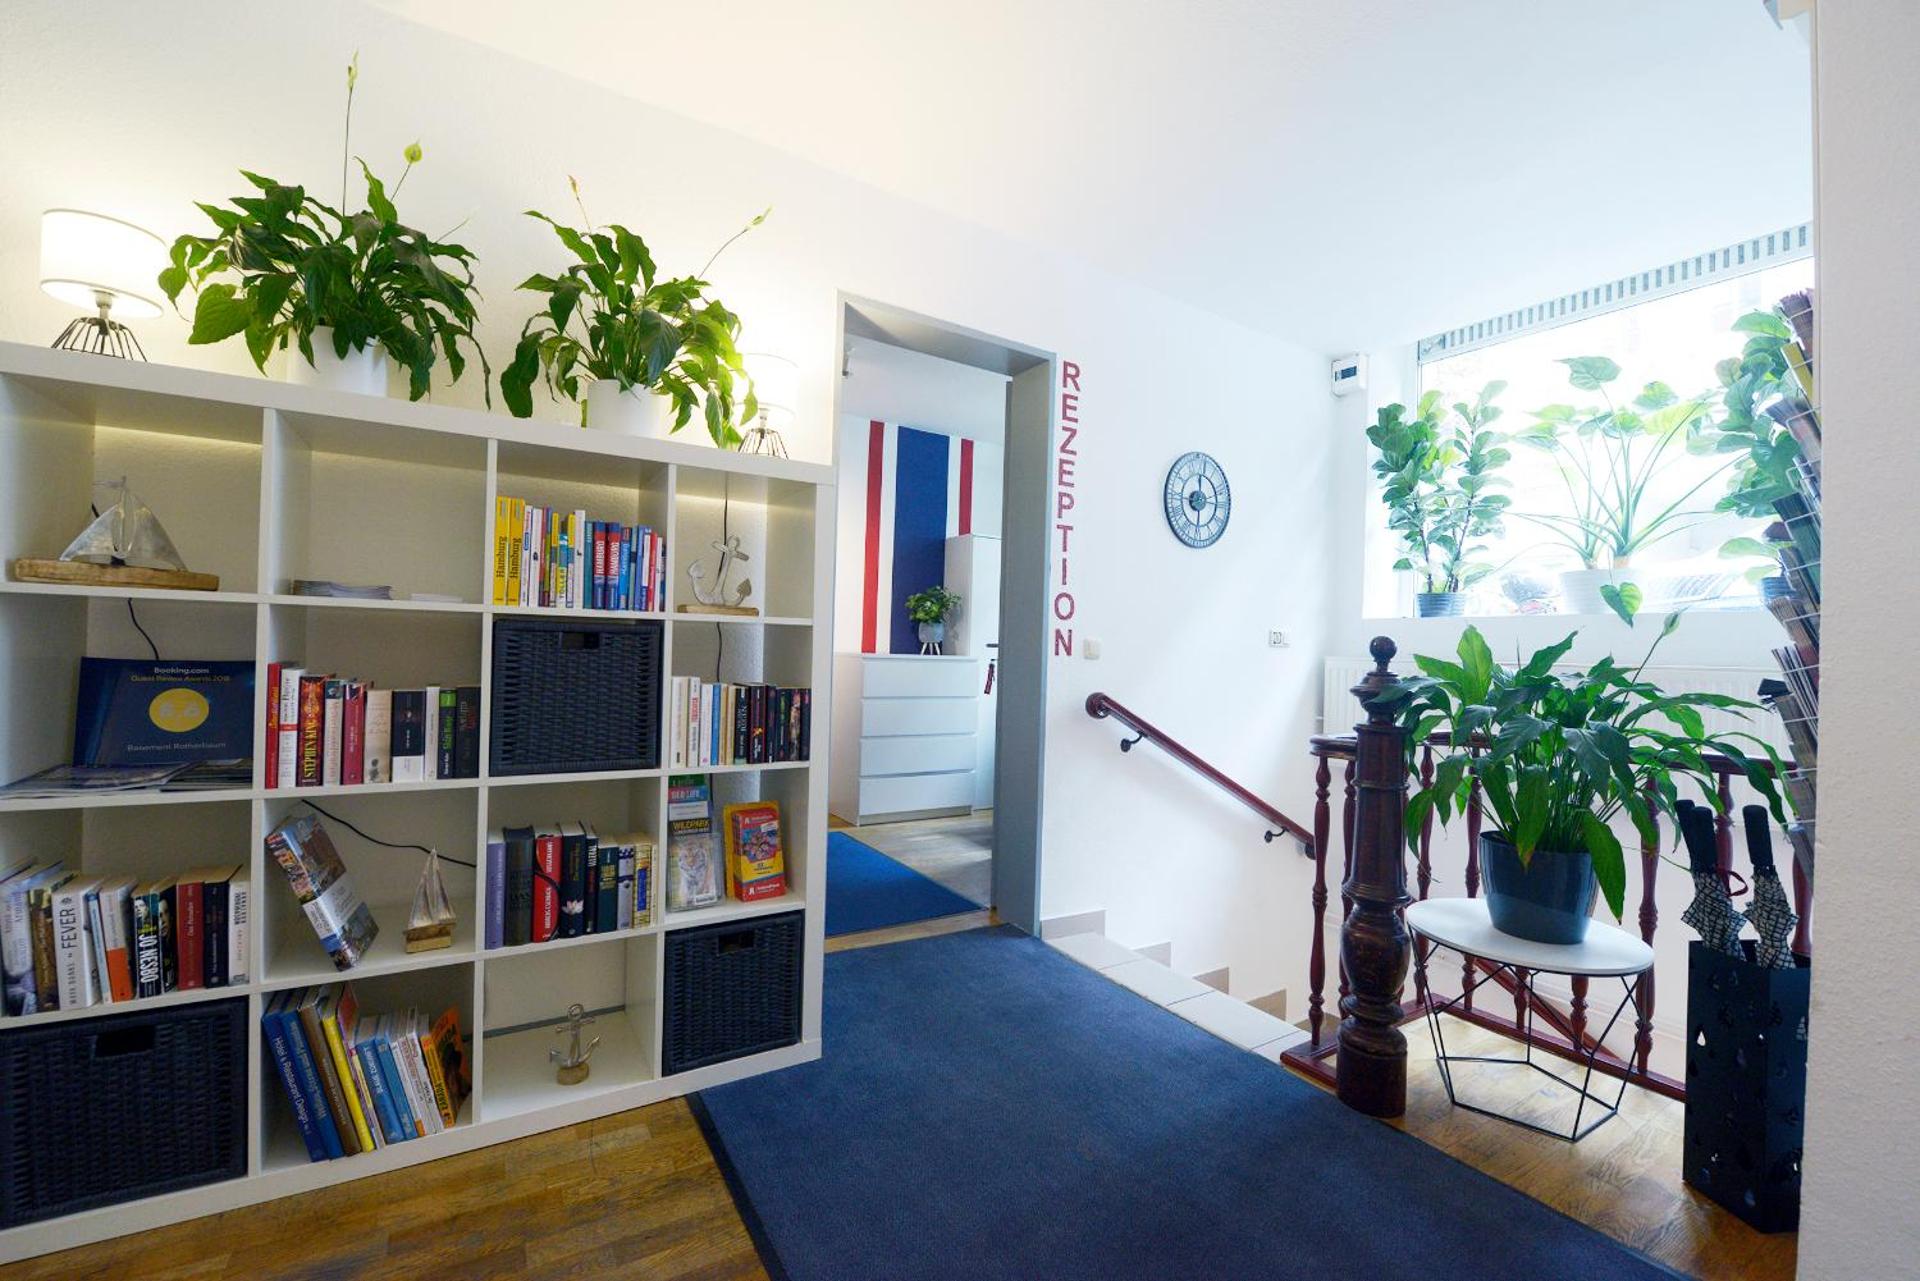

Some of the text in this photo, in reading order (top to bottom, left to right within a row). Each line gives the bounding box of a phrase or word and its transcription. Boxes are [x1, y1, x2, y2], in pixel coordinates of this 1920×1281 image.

[1054, 359, 1081, 658] REZEPTION
[495, 535, 507, 578] Hamburg
[508, 536, 521, 579] Hamburg
[154, 666, 209, 676] Booking.com
[303, 739, 317, 778] STEPHEN
[59, 907, 78, 949] FEVER
[139, 933, 159, 948] JO
[274, 1037, 287, 1055] Hotel
[282, 1062, 301, 1099] Restaurant
[296, 1098, 309, 1123] Design
